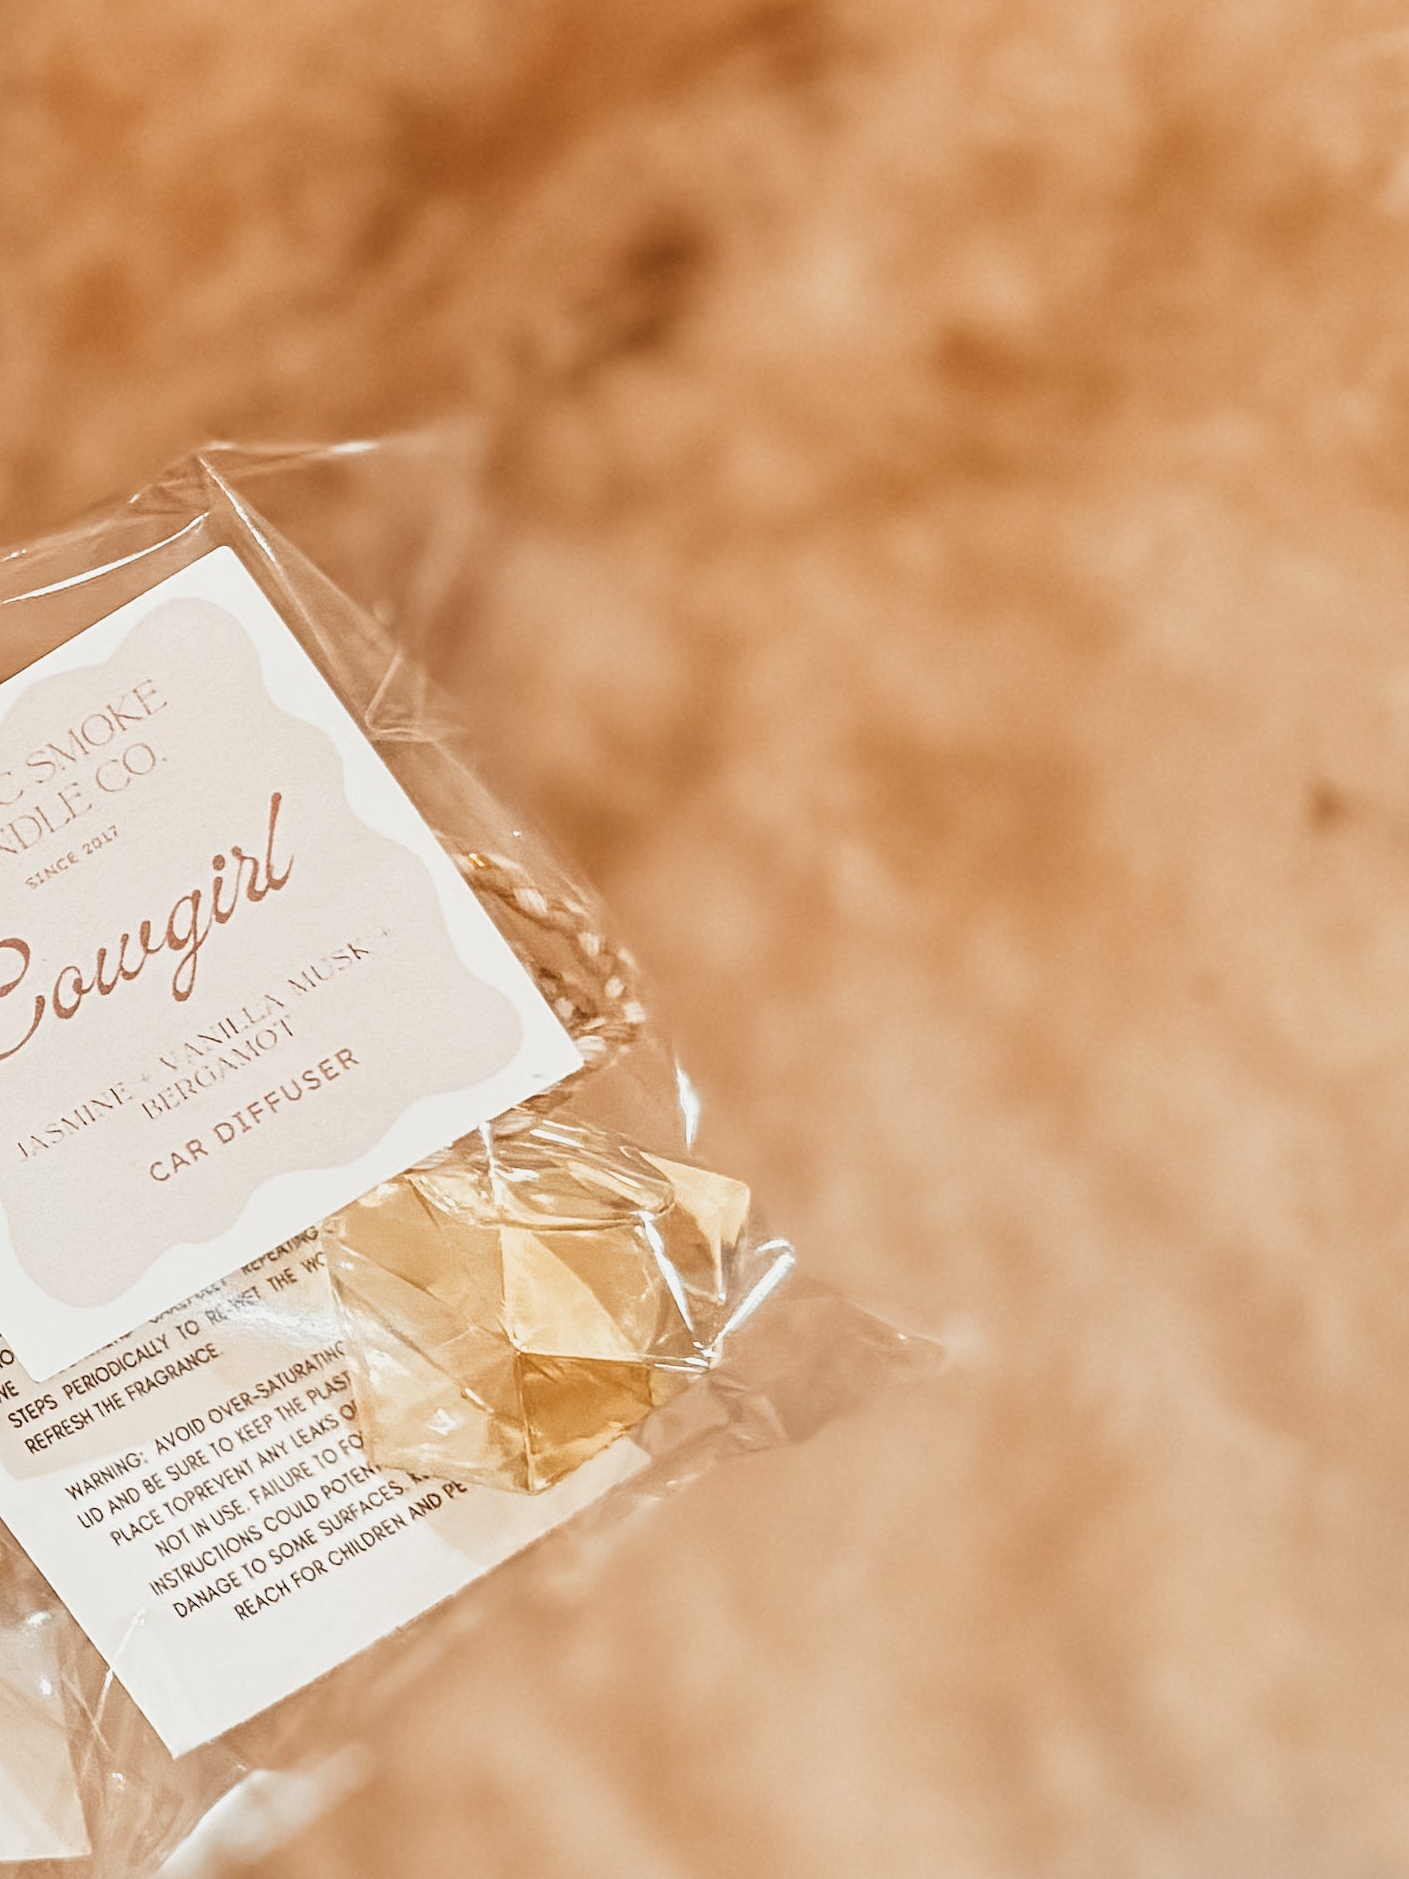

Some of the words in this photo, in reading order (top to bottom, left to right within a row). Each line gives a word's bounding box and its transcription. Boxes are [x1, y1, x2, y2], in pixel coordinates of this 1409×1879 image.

[25, 678, 167, 783] SMOKE
[95, 742, 167, 792] CO.
[25, 851, 79, 889] SINCE
[82, 825, 120, 855] 2017
[18, 1082, 133, 1162] JASMINE
[159, 994, 285, 1071] VANILLA
[288, 938, 372, 996] MUSK
[141, 1014, 294, 1120] BERGAMOT
[150, 1138, 209, 1182] CAR
[213, 1047, 360, 1144] DIFFUSER
[7, 1393, 59, 1429] STEPS
[61, 1333, 171, 1401] PERIODICALLY
[175, 1320, 201, 1340] TO
[266, 1267, 298, 1293] THE
[24, 1408, 95, 1455] REFRESH
[92, 1392, 126, 1418] THE
[64, 1451, 149, 1501] WARNING:
[154, 1418, 207, 1455] AVOID
[76, 1506, 105, 1529] LID
[107, 1487, 141, 1516] AND
[141, 1472, 166, 1495] BE
[165, 1449, 210, 1482] SURE
[209, 1436, 235, 1458] TO
[235, 1413, 273, 1445] KEEP
[274, 1397, 307, 1423] THE
[109, 1509, 165, 1547] PLACE
[163, 1458, 255, 1517] TOPREVENT
[256, 1441, 290, 1469] ANY
[290, 1413, 340, 1449] LEAKS
[154, 1527, 191, 1557] NOT
[191, 1518, 212, 1538] IN
[209, 1498, 252, 1526] USE.
[248, 1461, 314, 1506] FAILURE
[312, 1448, 339, 1470] TO
[148, 1524, 264, 1597] INSTRUCTIONS
[263, 1493, 320, 1533] COULD
[233, 1578, 292, 1622] REACH
[290, 1558, 329, 1589] FOR
[328, 1513, 409, 1567] CHILDREN
[407, 1491, 443, 1521] AND
[241, 1557, 268, 1580] TO
[268, 1528, 319, 1565] SOME
